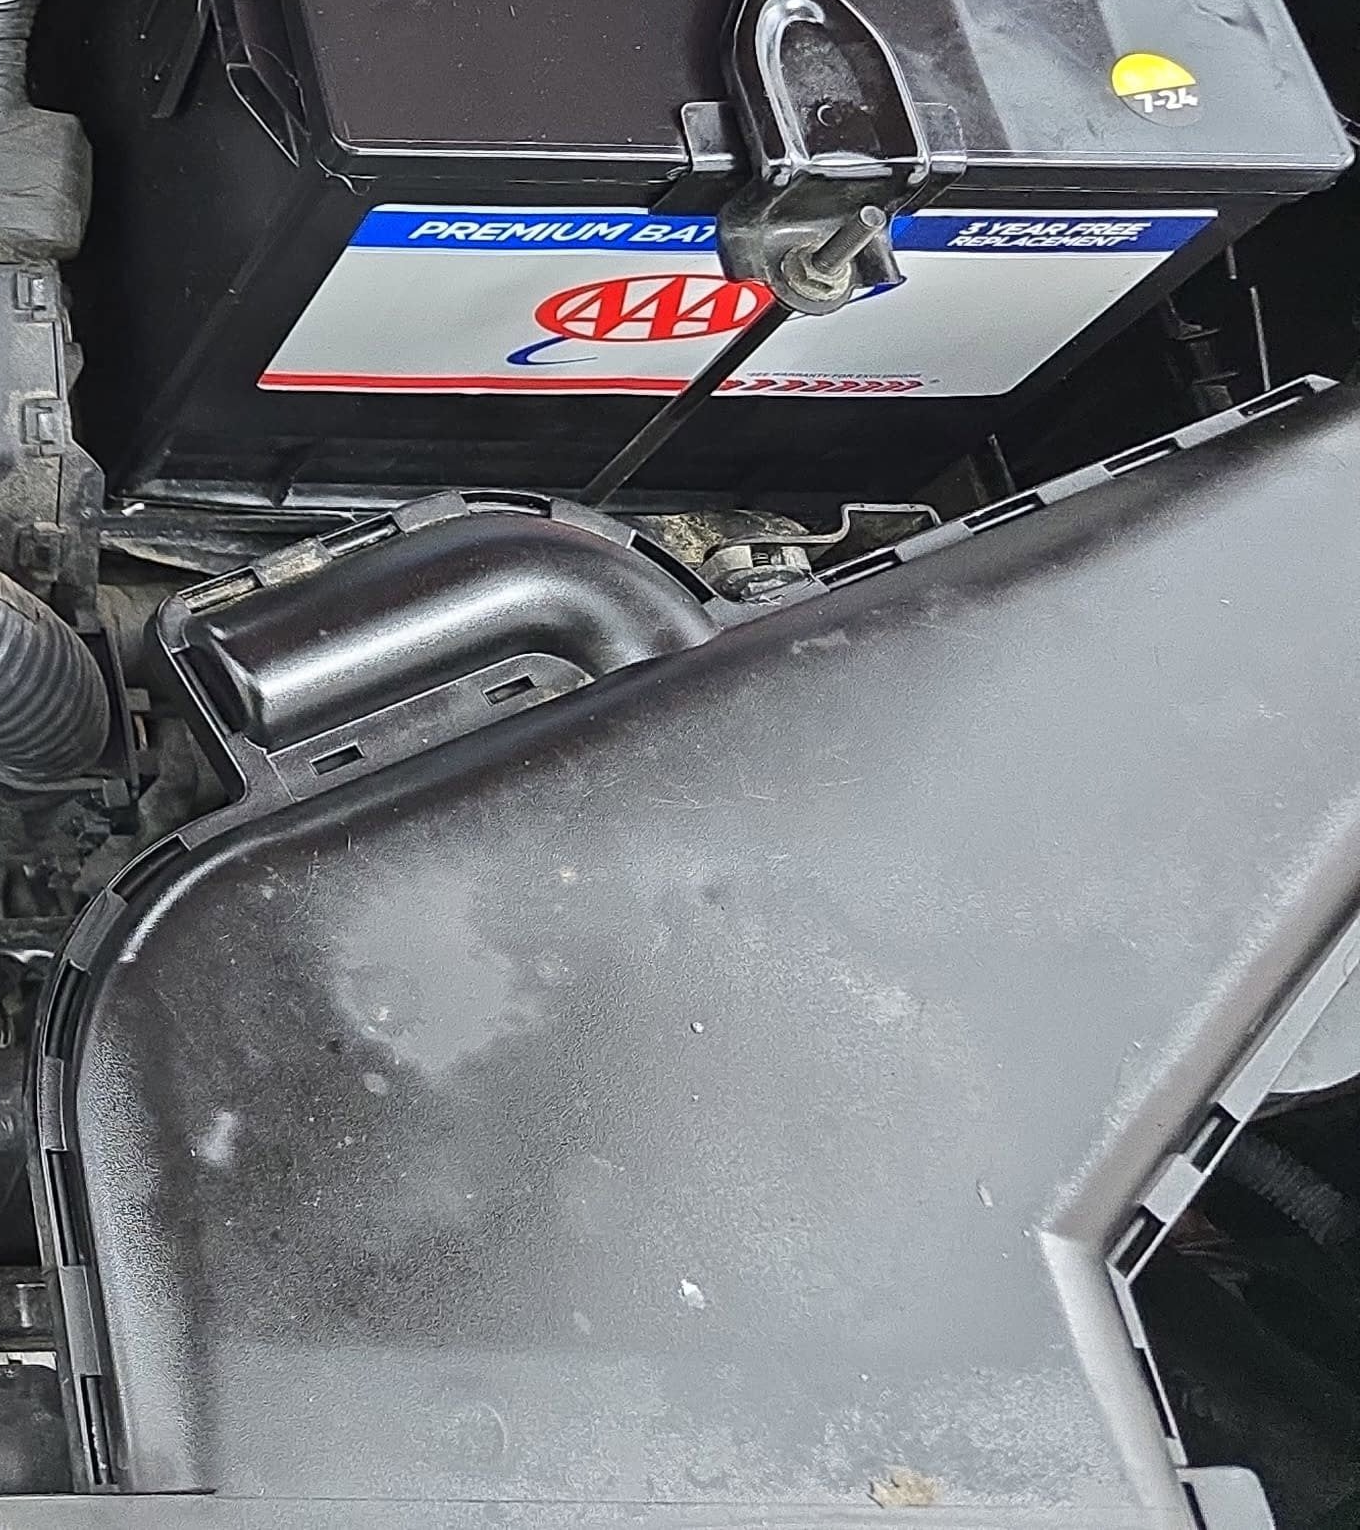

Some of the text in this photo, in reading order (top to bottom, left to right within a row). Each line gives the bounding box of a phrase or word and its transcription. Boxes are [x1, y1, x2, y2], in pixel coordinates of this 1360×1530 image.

[408, 222, 628, 242] PREMIUM
[986, 222, 1069, 235] YEAR
[1065, 222, 1152, 235] FREE
[542, 275, 770, 340] AAA
